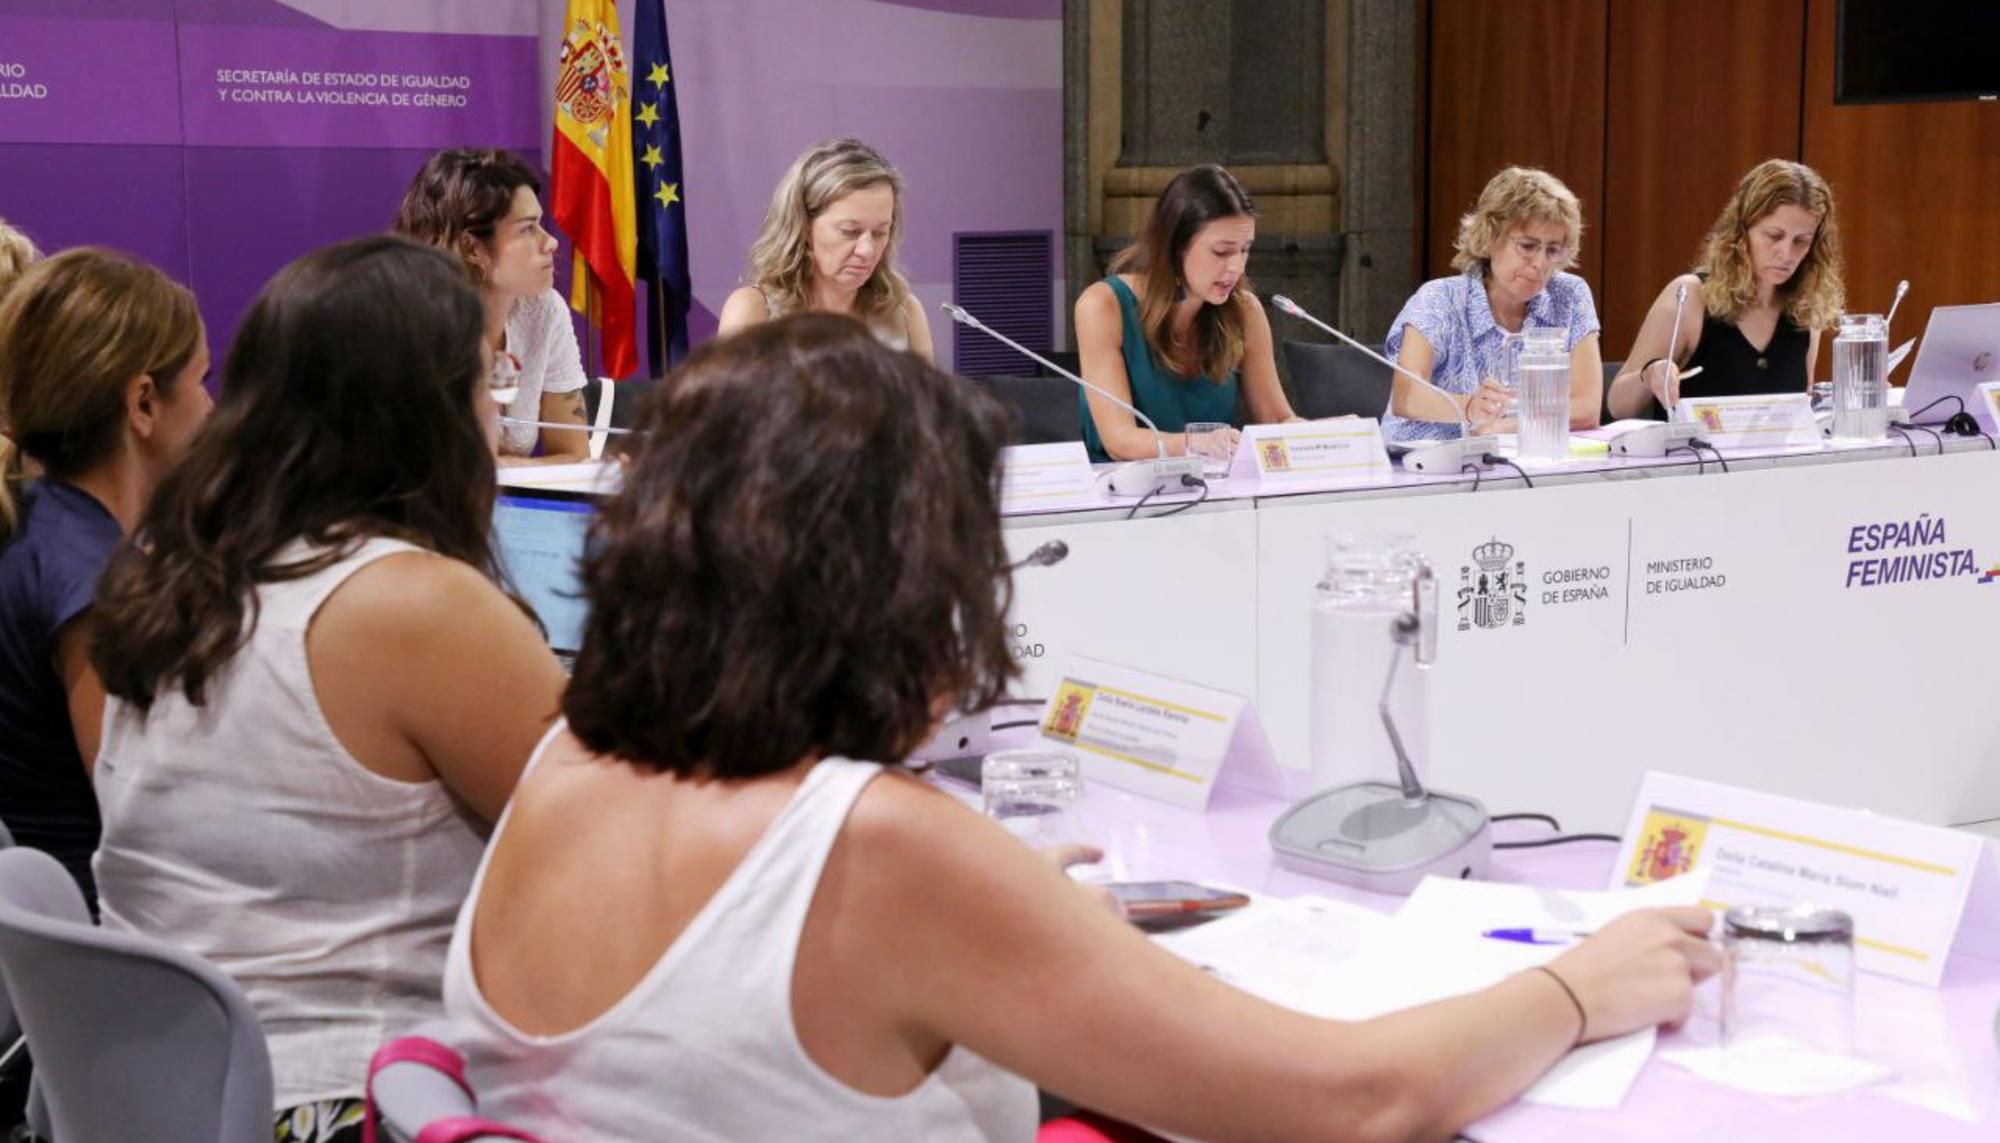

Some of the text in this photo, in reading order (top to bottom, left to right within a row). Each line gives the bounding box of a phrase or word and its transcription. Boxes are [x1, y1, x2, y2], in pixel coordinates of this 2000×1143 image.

[216, 68, 470, 89] SECRETARÍA DE ESTADO DE IGUALDAD
[218, 88, 228, 101] Y
[231, 89, 294, 103] CONTRA
[297, 91, 316, 104] LA
[315, 91, 389, 105] VIOLENCIA
[391, 93, 410, 106] DE
[1847, 513, 1945, 553] ESPAÑA
[1646, 556, 1713, 574] MINISTERIO
[1845, 548, 1980, 588] FEMINISTA.
[1542, 566, 1610, 584] GOBIERNO
[1646, 575, 1726, 594] DE IGUALDAD
[1542, 585, 1609, 605] DE ESPAÑA
